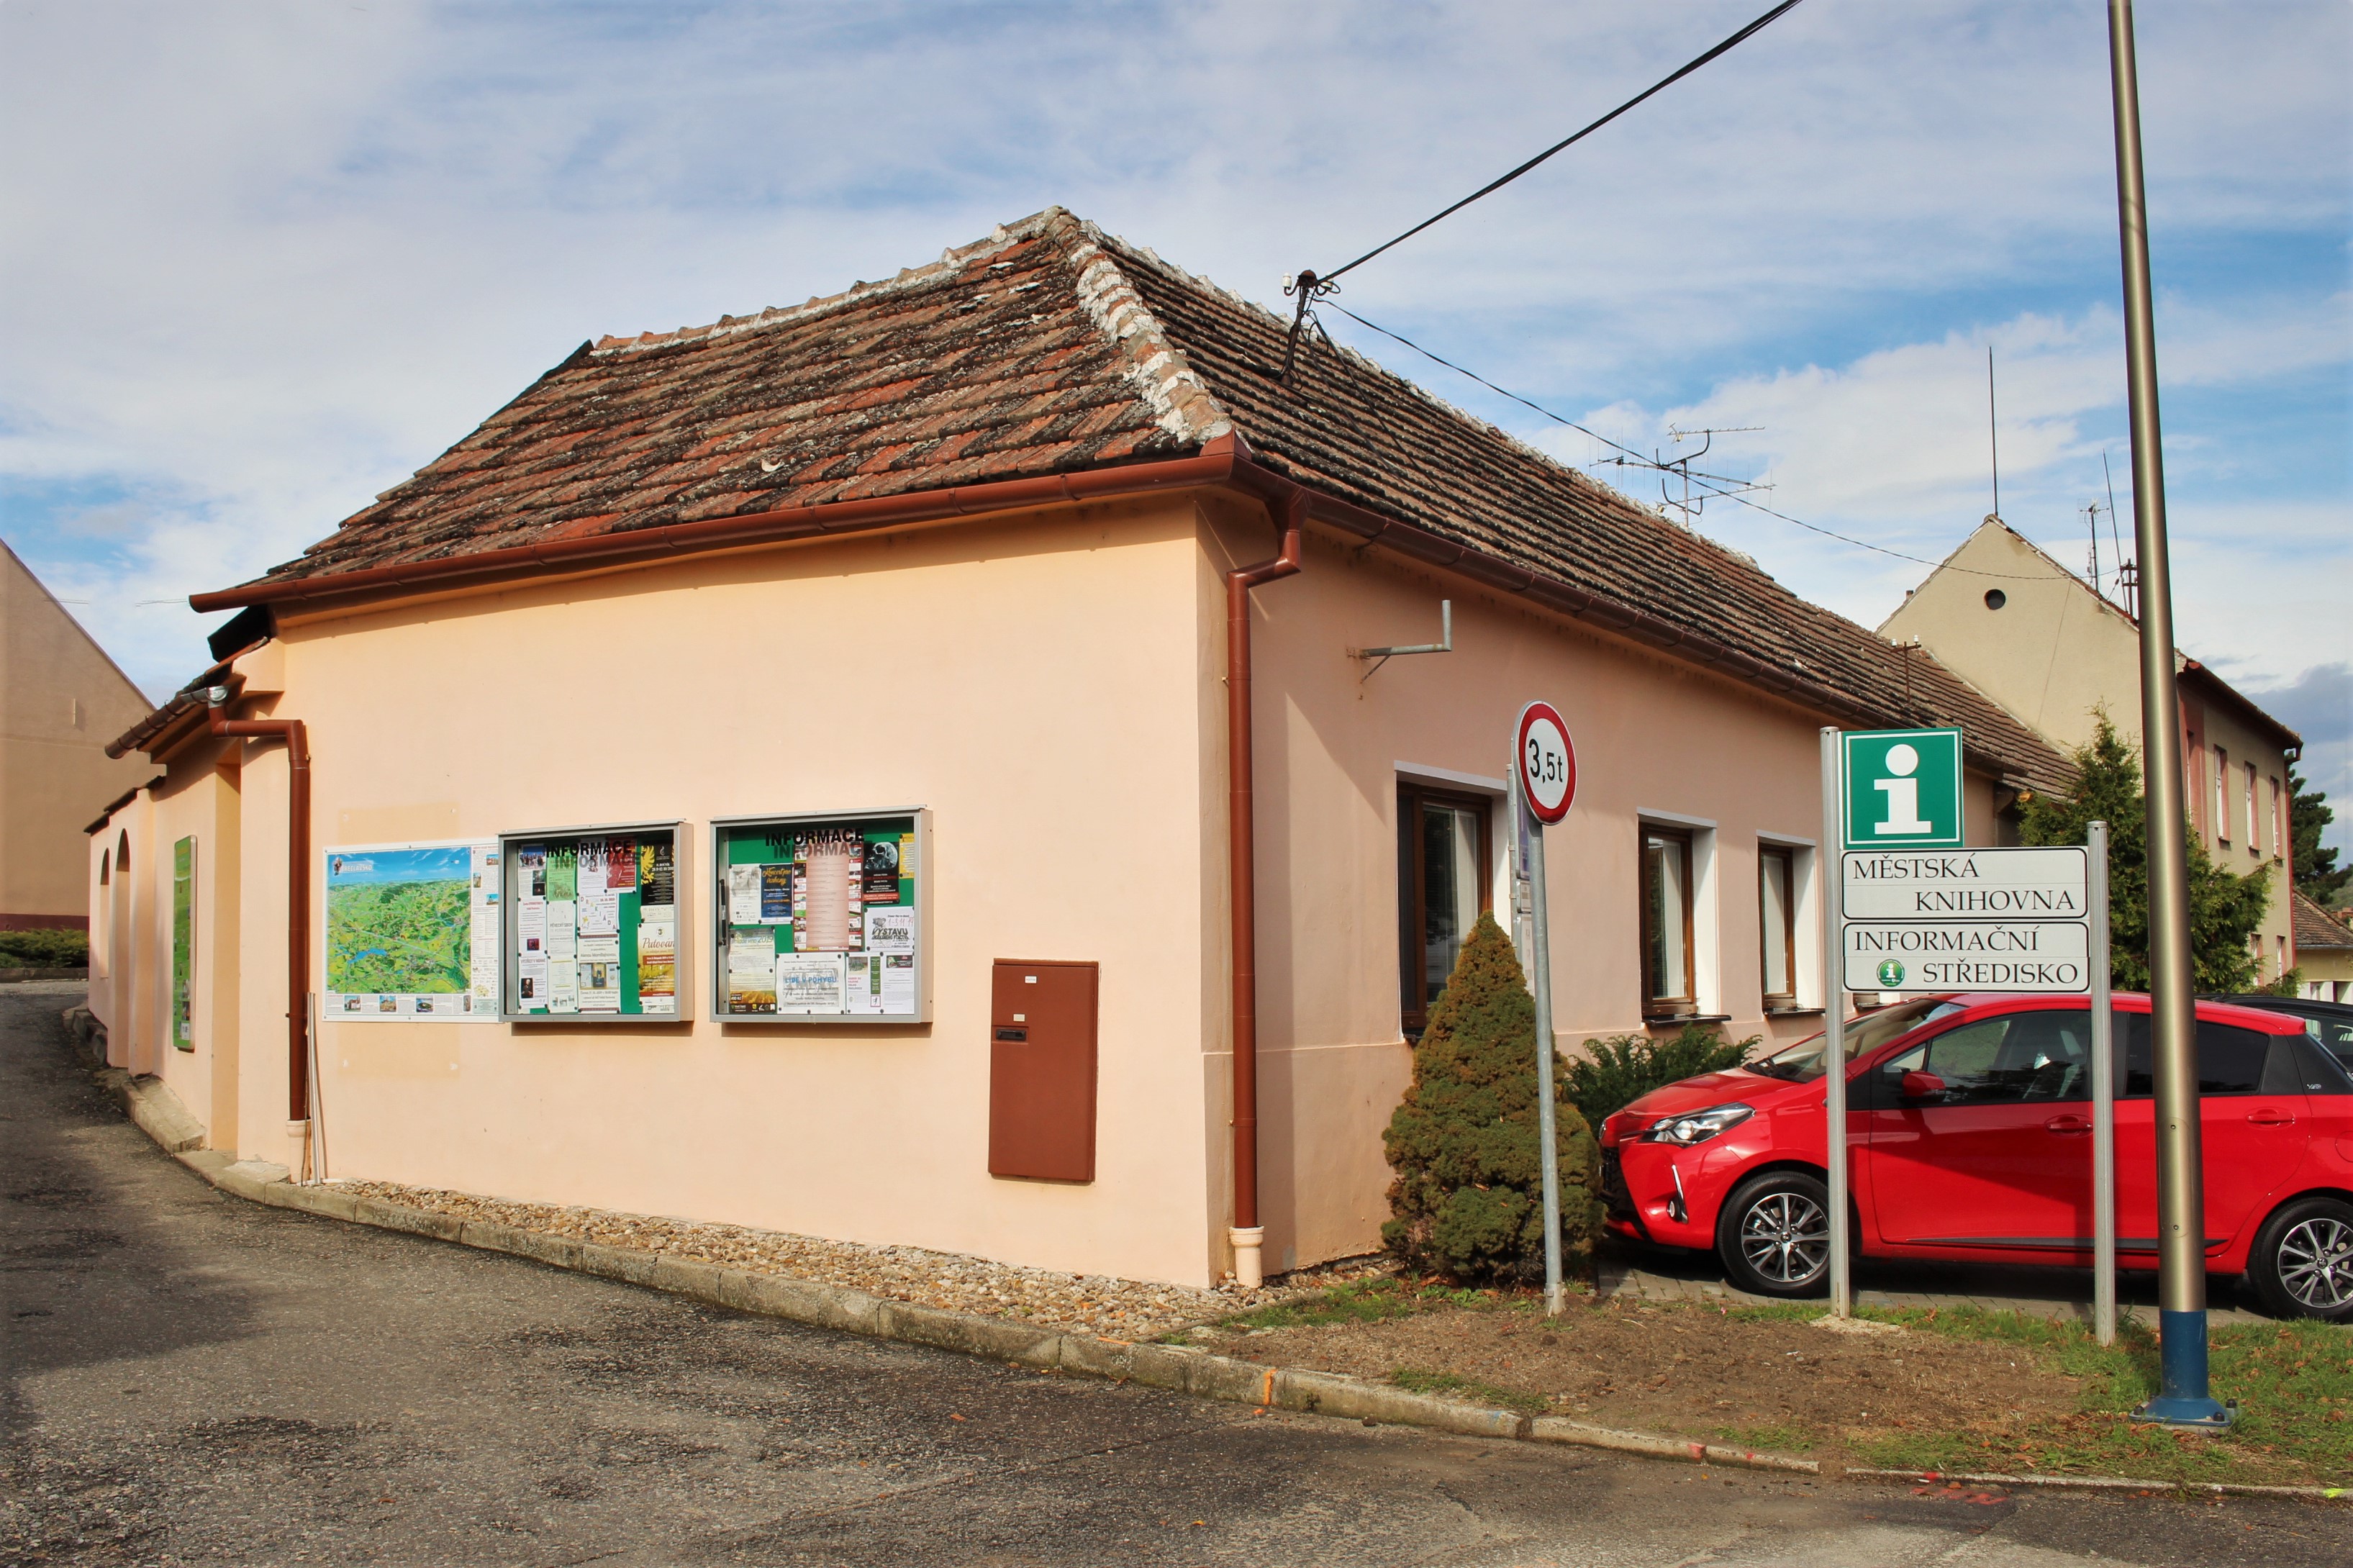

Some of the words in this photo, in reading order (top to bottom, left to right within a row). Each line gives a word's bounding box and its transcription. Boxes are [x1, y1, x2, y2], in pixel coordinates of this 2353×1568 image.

[765, 828, 865, 846] INFORMACE
[546, 840, 633, 858] INFORMACE
[1853, 853, 1980, 879] MĚSTSKÁ
[1915, 890, 2075, 911] KNIHOVNA
[1854, 925, 2039, 951] INFORMAČNÍ
[1923, 958, 2078, 984] STŘEDISKO
